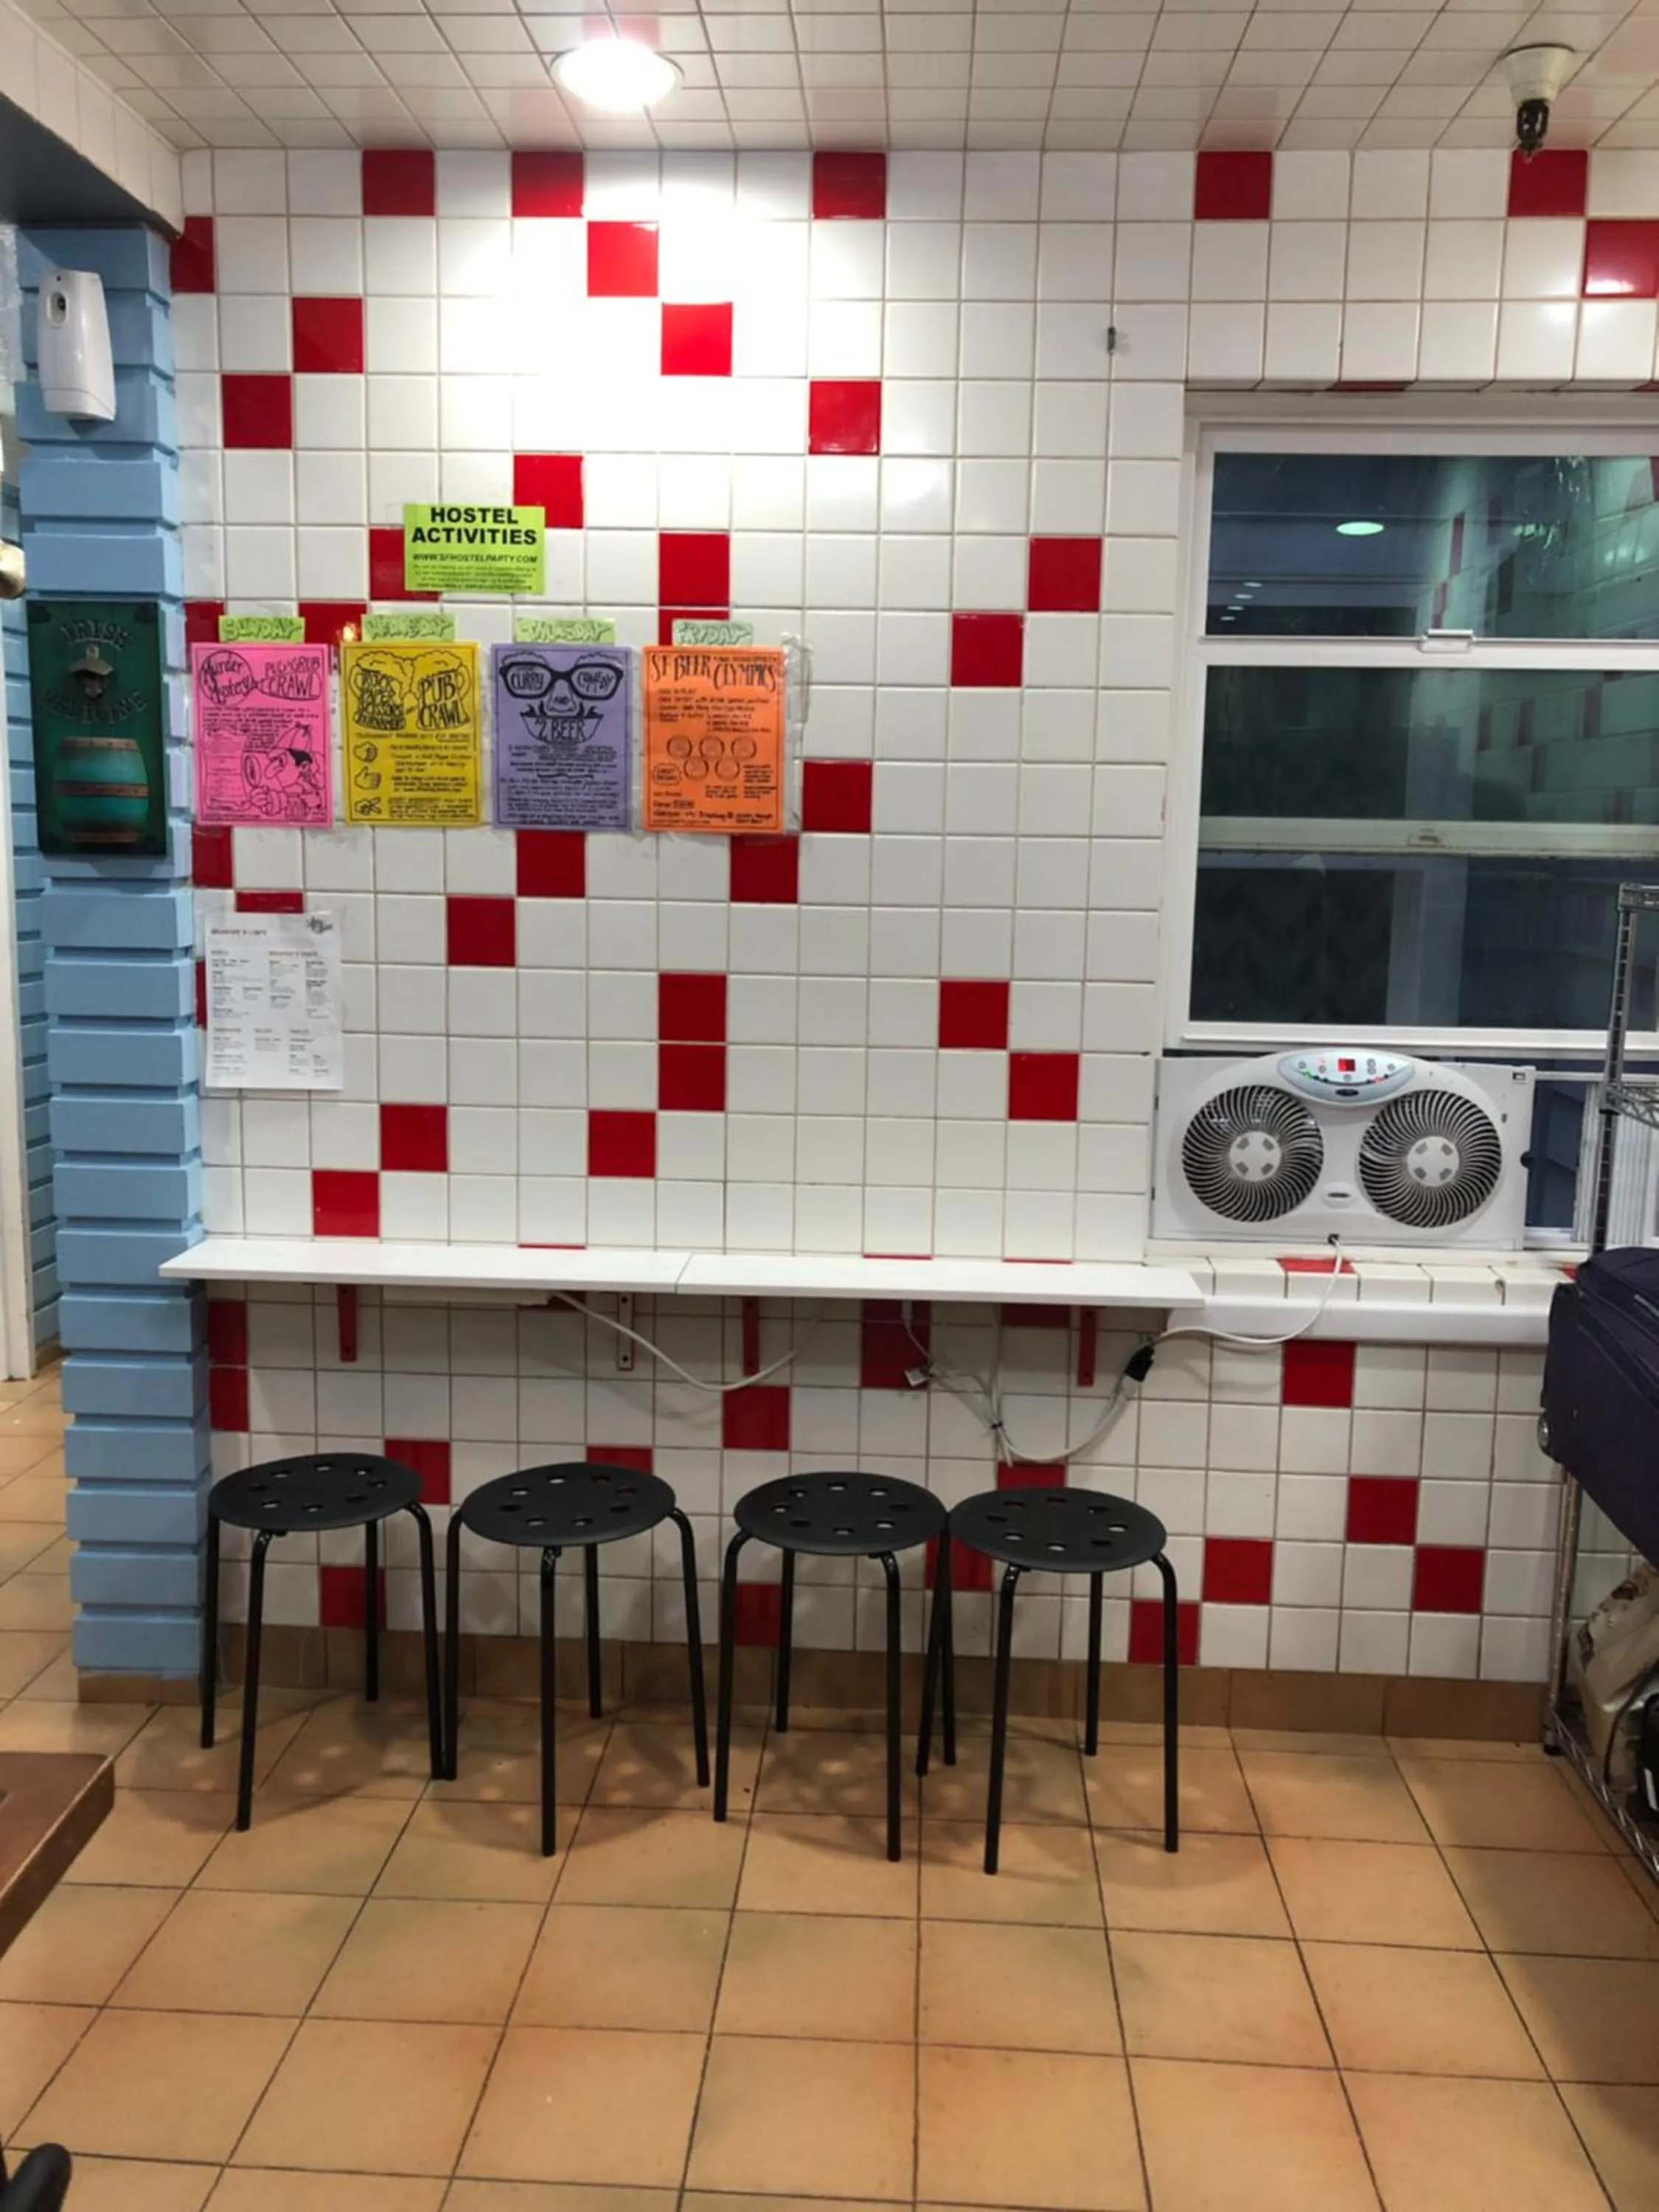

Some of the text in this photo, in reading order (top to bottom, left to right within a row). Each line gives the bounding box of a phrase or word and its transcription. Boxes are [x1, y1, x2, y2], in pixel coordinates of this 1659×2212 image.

[431, 507, 518, 524] HOSTEL
[411, 527, 537, 545] ACTIVITIES
[413, 554, 538, 563] WWW.SFHOSTELPARTY.COM
[222, 616, 304, 641] SUNDAY
[675, 621, 752, 645] FRIDAY
[674, 654, 711, 682] BEER
[267, 672, 319, 700] CRAWL
[419, 673, 457, 706] PUB
[420, 699, 462, 729] CRAWL
[551, 717, 586, 739] BEER
